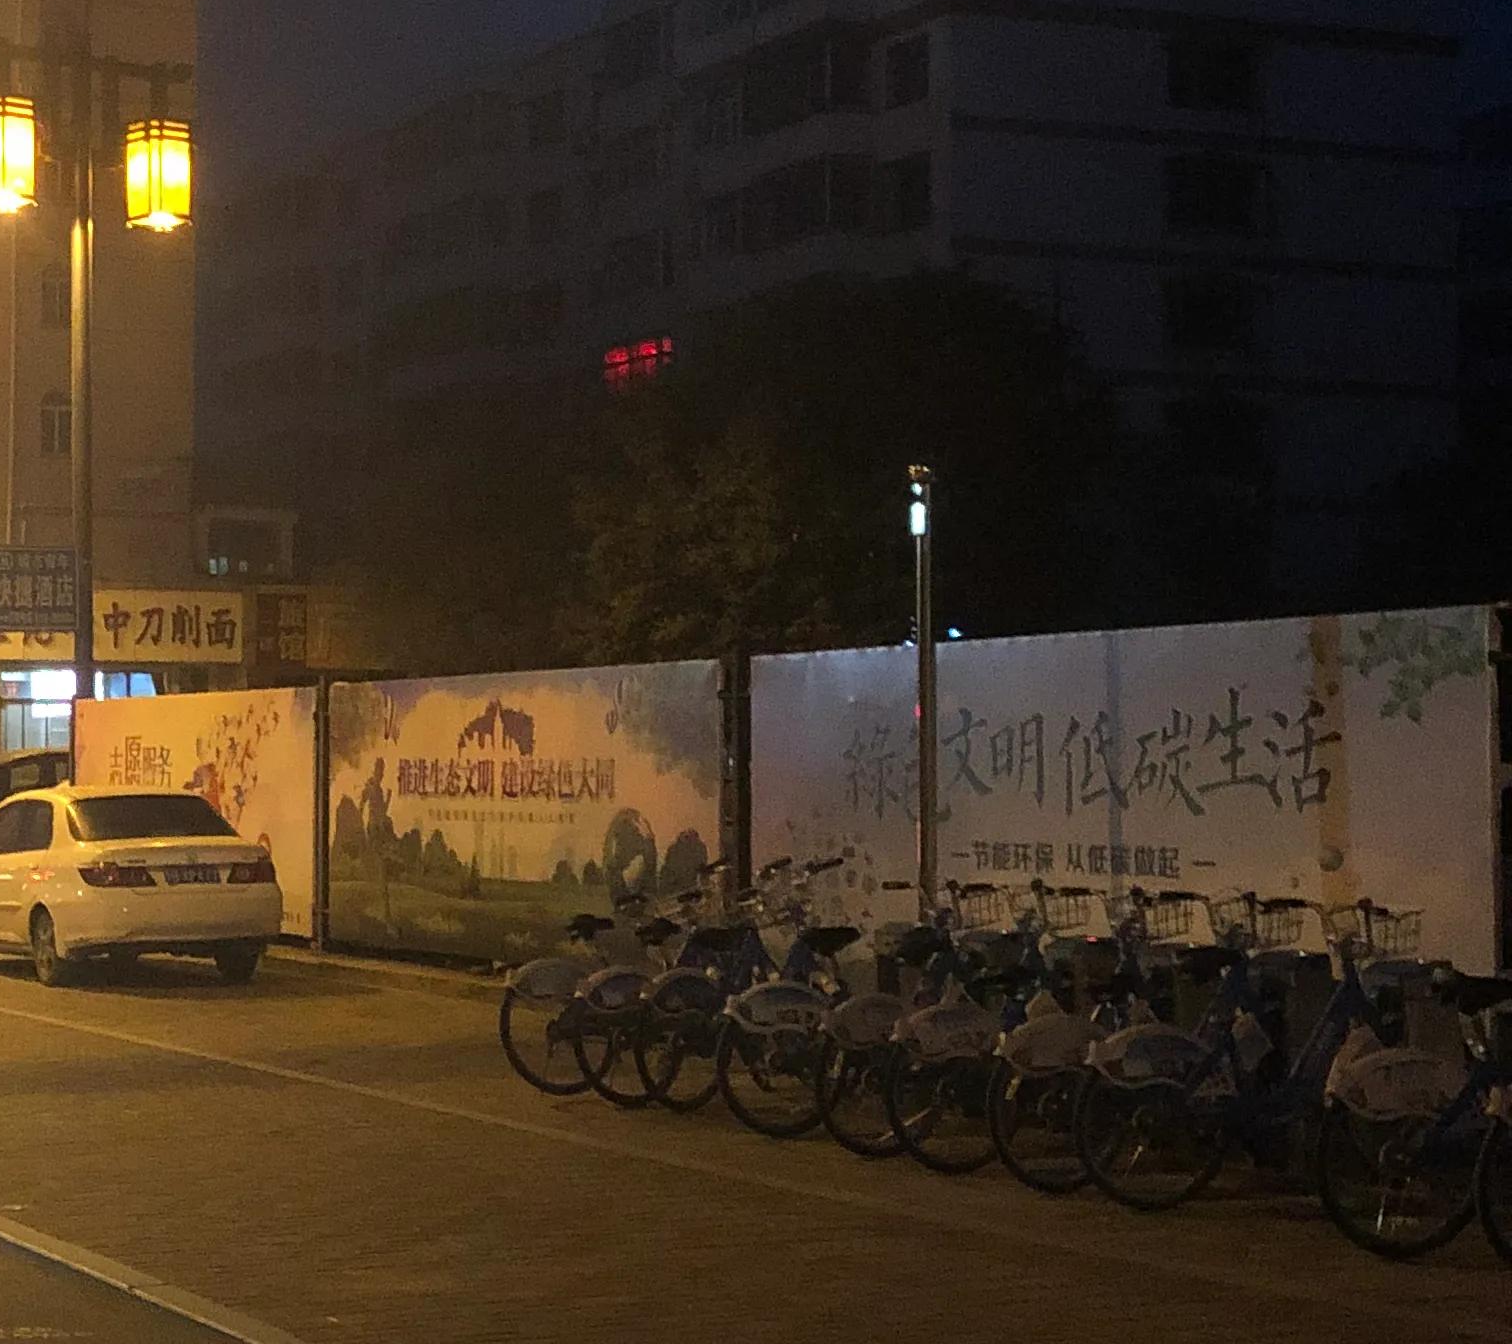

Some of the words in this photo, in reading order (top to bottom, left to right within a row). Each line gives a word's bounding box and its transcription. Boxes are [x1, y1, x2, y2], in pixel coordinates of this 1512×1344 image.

[103, 601, 237, 650] 中刀削面
[398, 758, 494, 799] 推进生态文明
[501, 758, 616, 802] 建设绿色大同
[971, 840, 1054, 874] 节能环保
